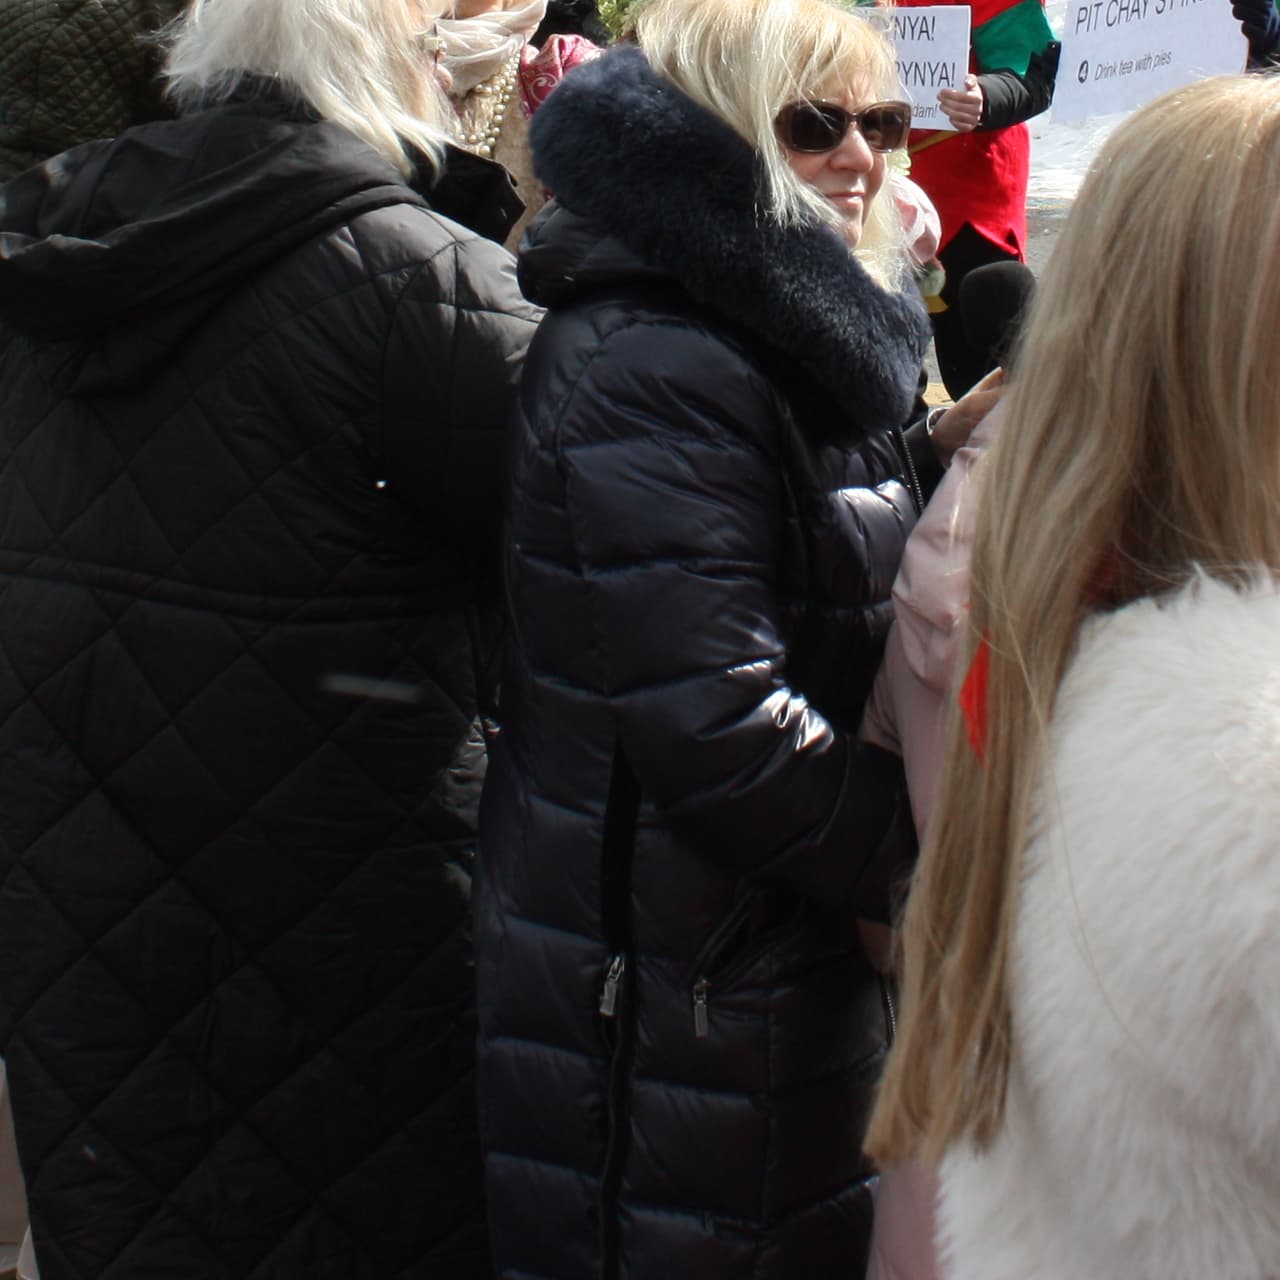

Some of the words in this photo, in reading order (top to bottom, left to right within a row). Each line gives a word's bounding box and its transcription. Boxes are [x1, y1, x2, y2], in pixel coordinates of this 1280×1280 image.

[886, 15, 936, 41] NYA!
[1076, 2, 1103, 35] PIT
[1094, 63, 1119, 81] Drink
[1119, 59, 1134, 75] tea
[1135, 53, 1153, 72] with
[1153, 50, 1172, 71] pies
